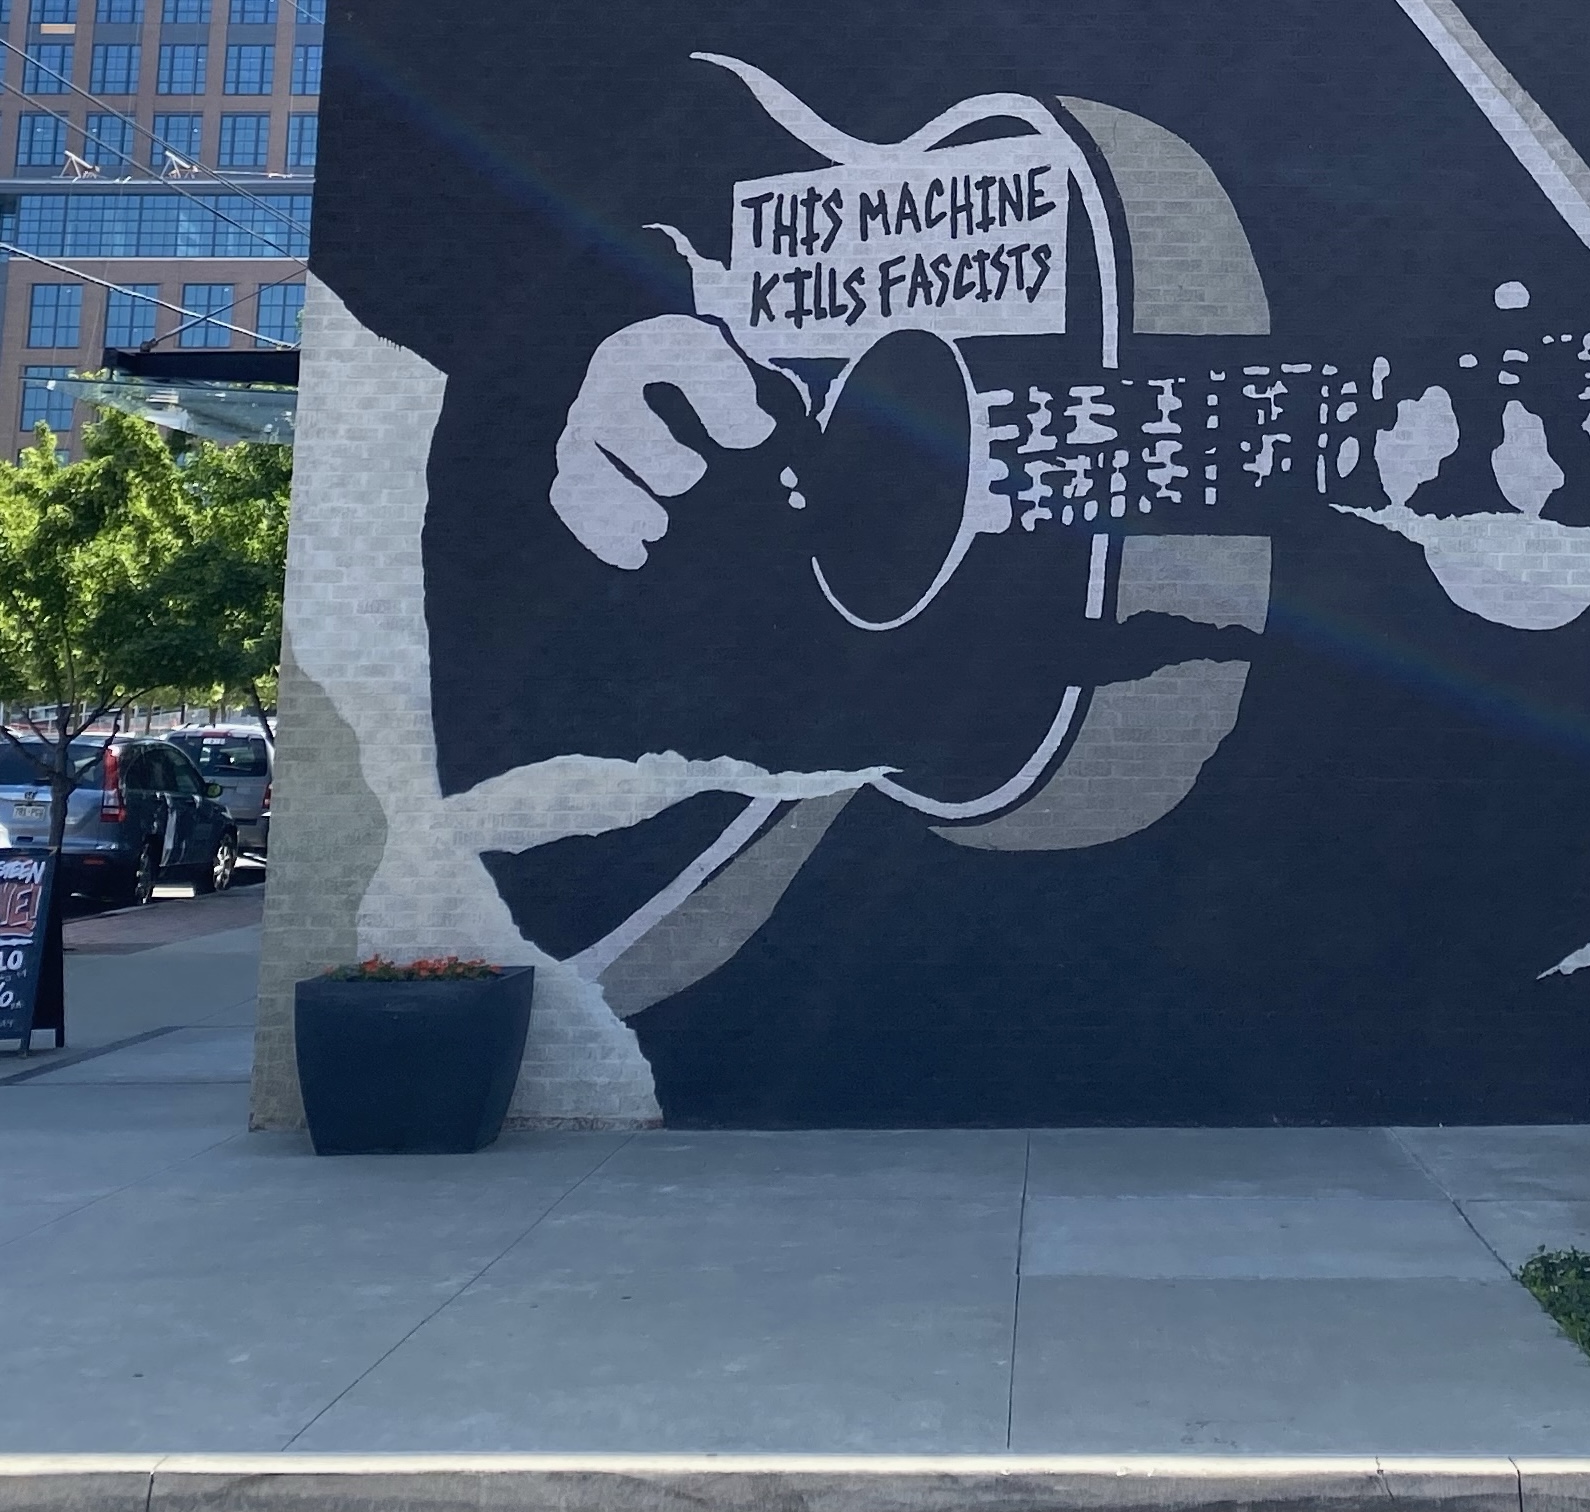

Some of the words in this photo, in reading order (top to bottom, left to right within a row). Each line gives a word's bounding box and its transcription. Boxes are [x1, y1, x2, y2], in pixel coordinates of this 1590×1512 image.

[741, 187, 844, 257] THIS
[859, 164, 1056, 241] MACHINE
[750, 262, 867, 329] KILLS
[879, 243, 1052, 317] FASCISTS
